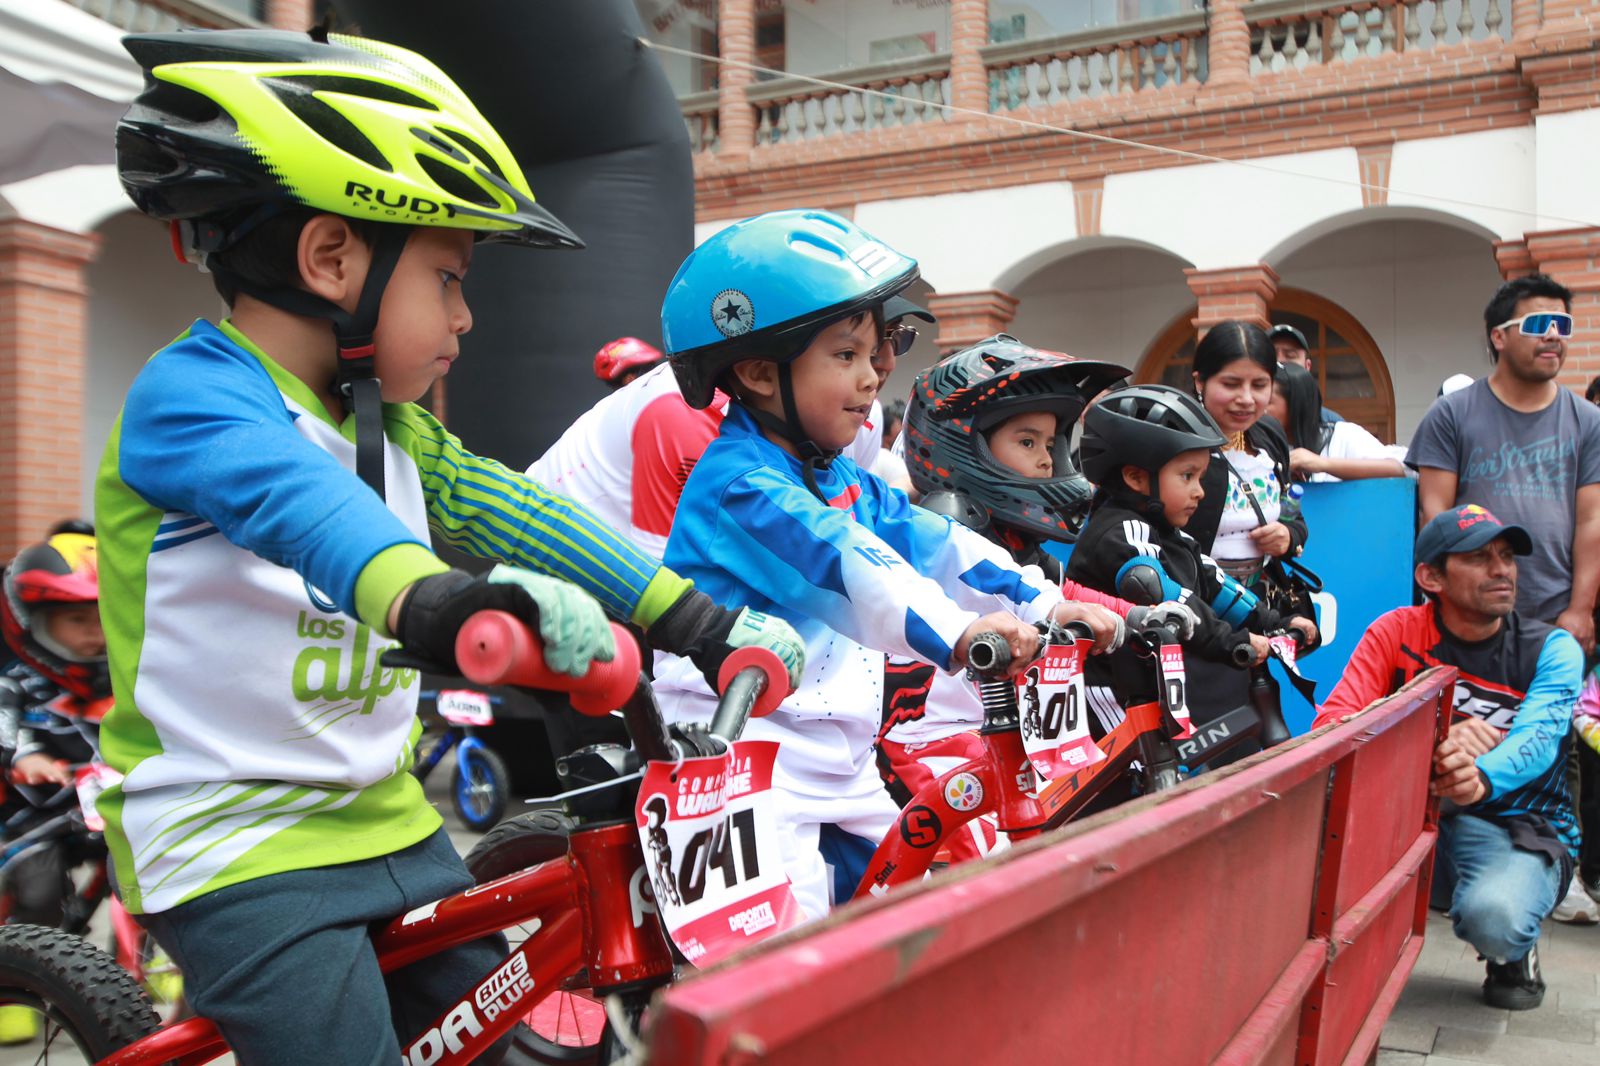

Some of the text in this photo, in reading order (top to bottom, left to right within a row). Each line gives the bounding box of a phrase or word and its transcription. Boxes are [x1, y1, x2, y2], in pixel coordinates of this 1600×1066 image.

[345, 181, 456, 218] RUDY
[297, 610, 346, 640] los
[679, 807, 760, 906] 041
[874, 860, 897, 885] Smt
[479, 956, 524, 1004] BIKE
[484, 972, 535, 1022] PLUS
